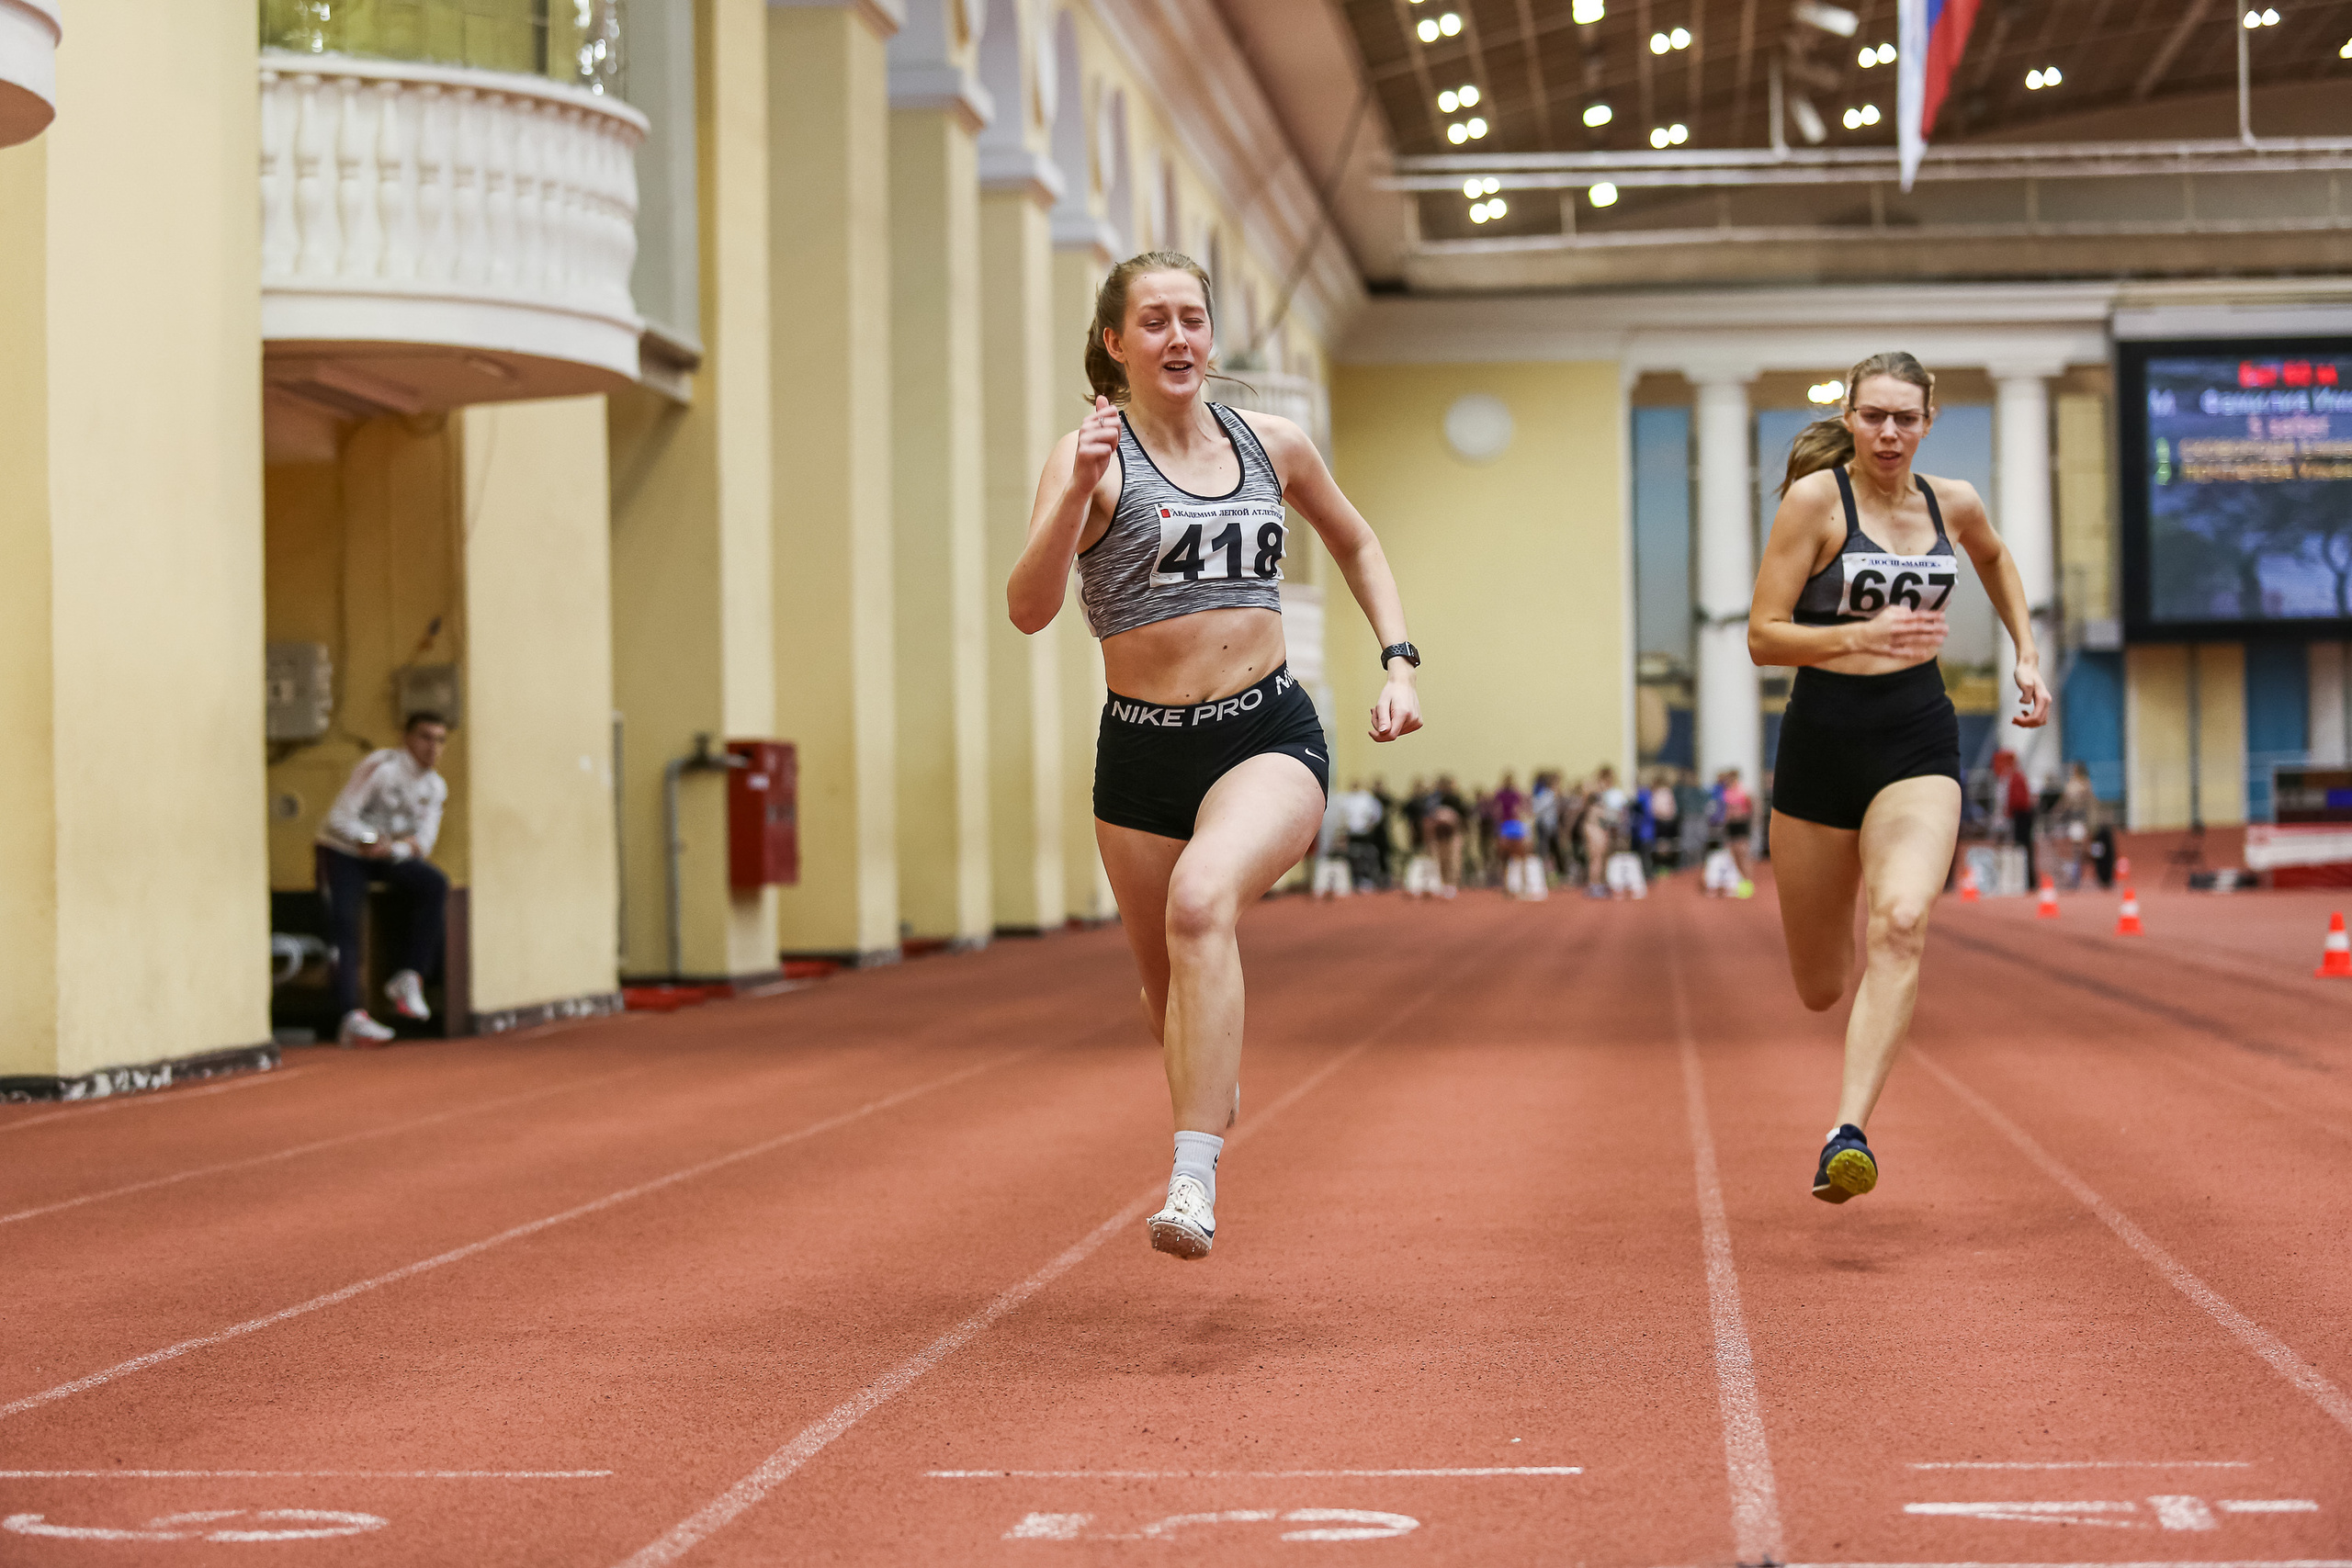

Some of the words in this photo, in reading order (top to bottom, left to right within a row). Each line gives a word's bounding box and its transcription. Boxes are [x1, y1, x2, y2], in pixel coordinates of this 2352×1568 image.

[1172, 510, 1217, 518] АКАДЕМИЯ
[1219, 508, 1250, 516] ЛЕГКОЙ
[1157, 522, 1283, 580] 418
[1849, 570, 1955, 613] 667
[1111, 700, 1186, 728] NIKE
[1192, 688, 1264, 727] PRO
